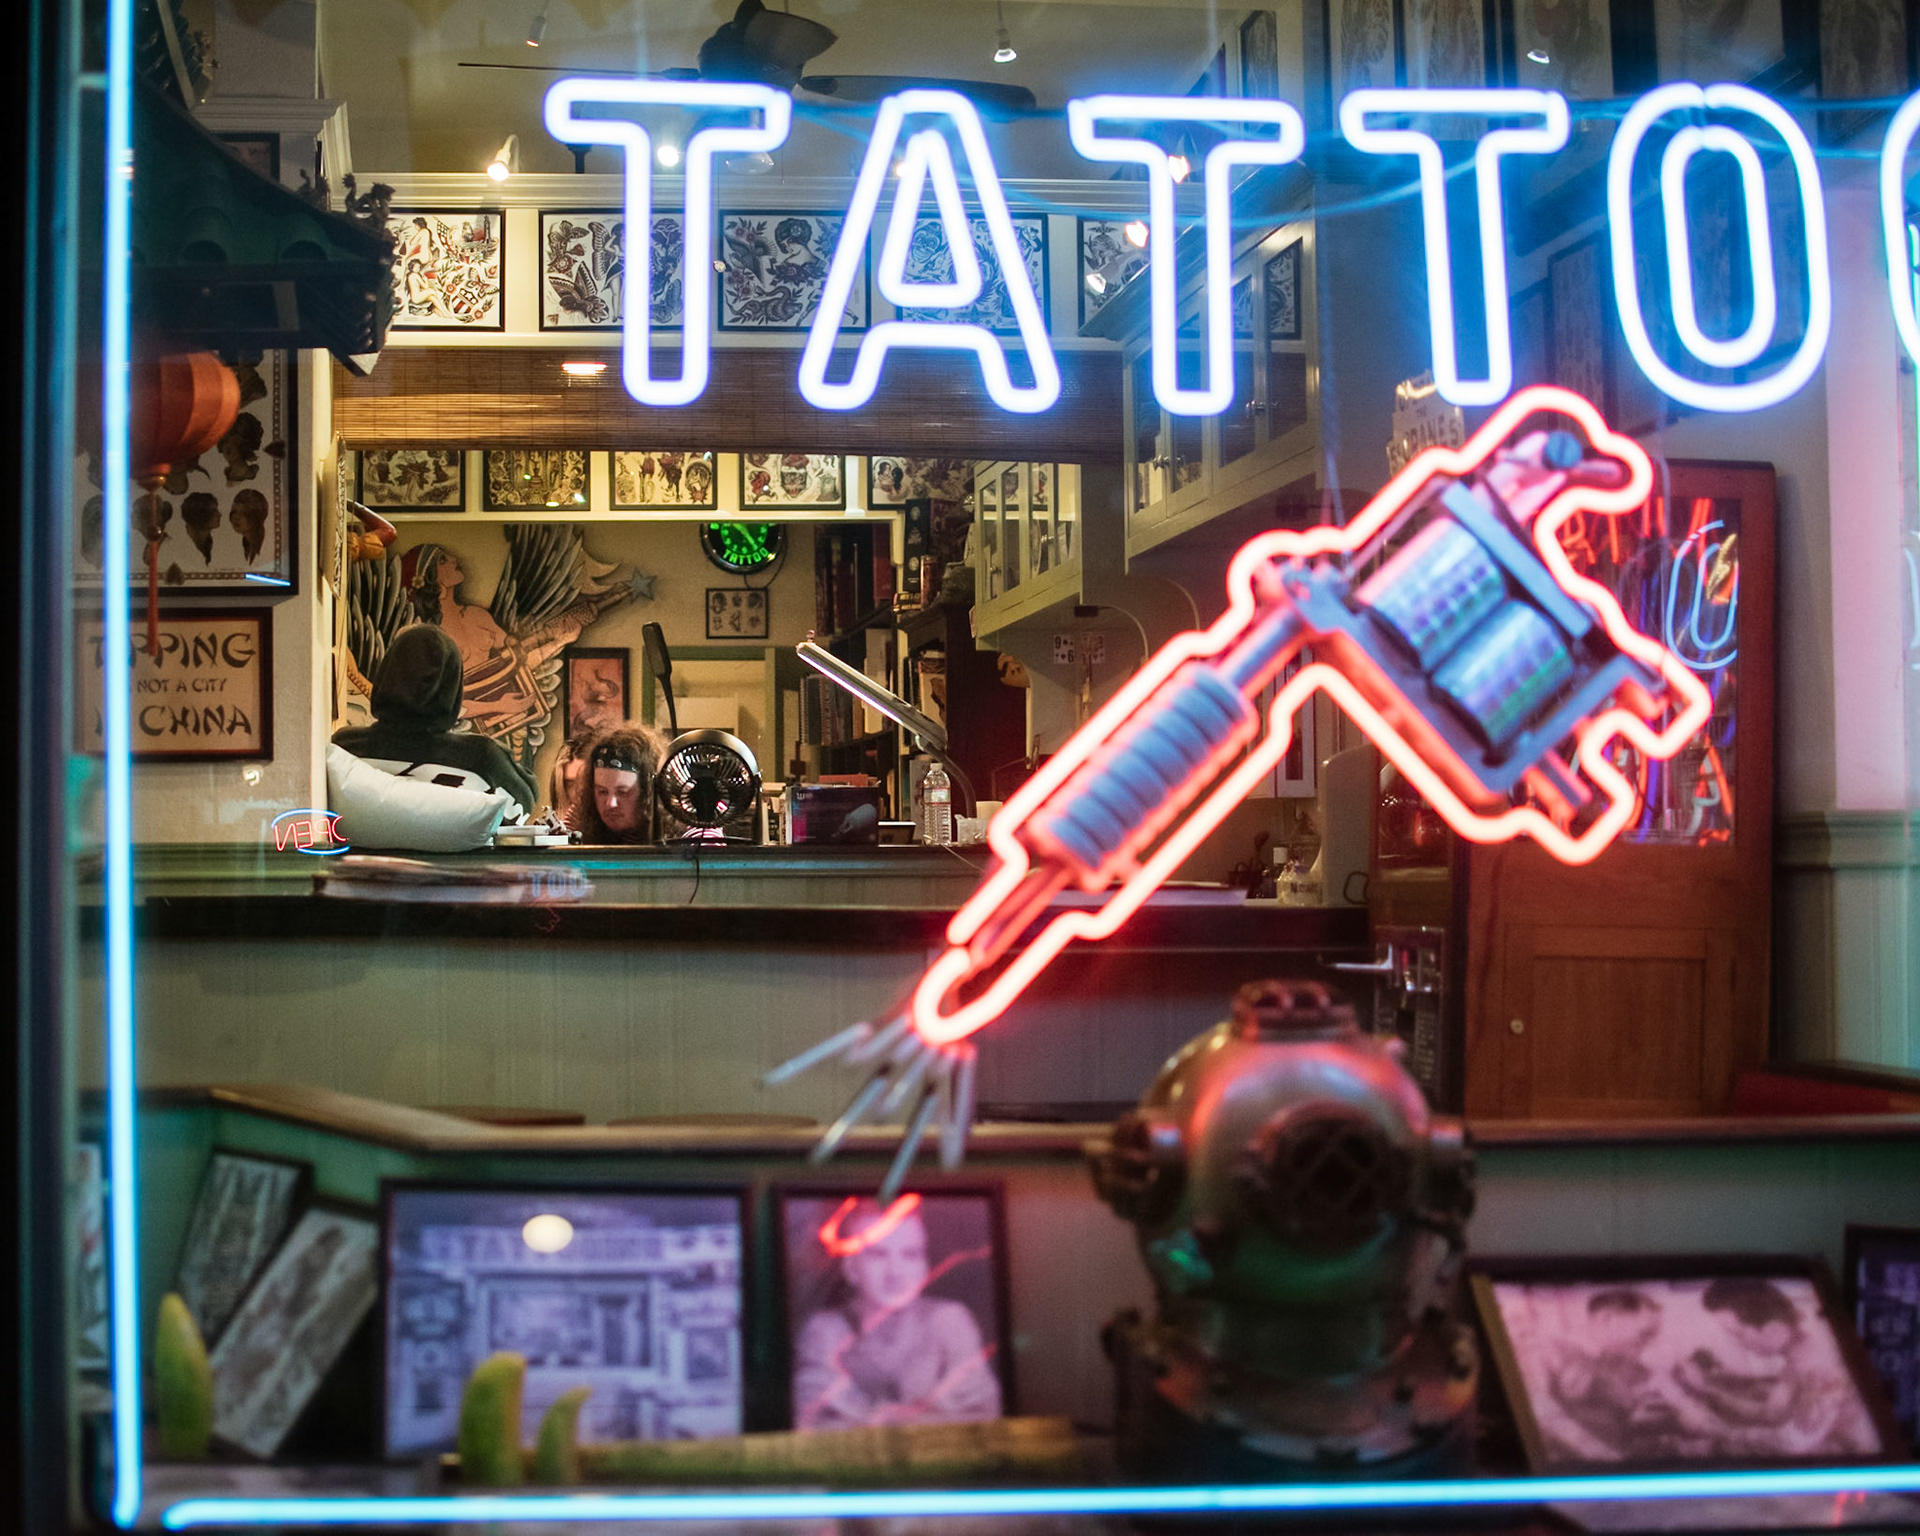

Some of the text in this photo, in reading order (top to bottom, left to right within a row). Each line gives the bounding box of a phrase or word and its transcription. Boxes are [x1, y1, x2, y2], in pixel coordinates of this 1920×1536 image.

[544, 78, 1920, 415] TATTO
[723, 546, 769, 565] TATTOO
[88, 632, 256, 669] TPPING
[137, 678, 227, 693] NOT A CITY
[138, 704, 252, 737] CHINA
